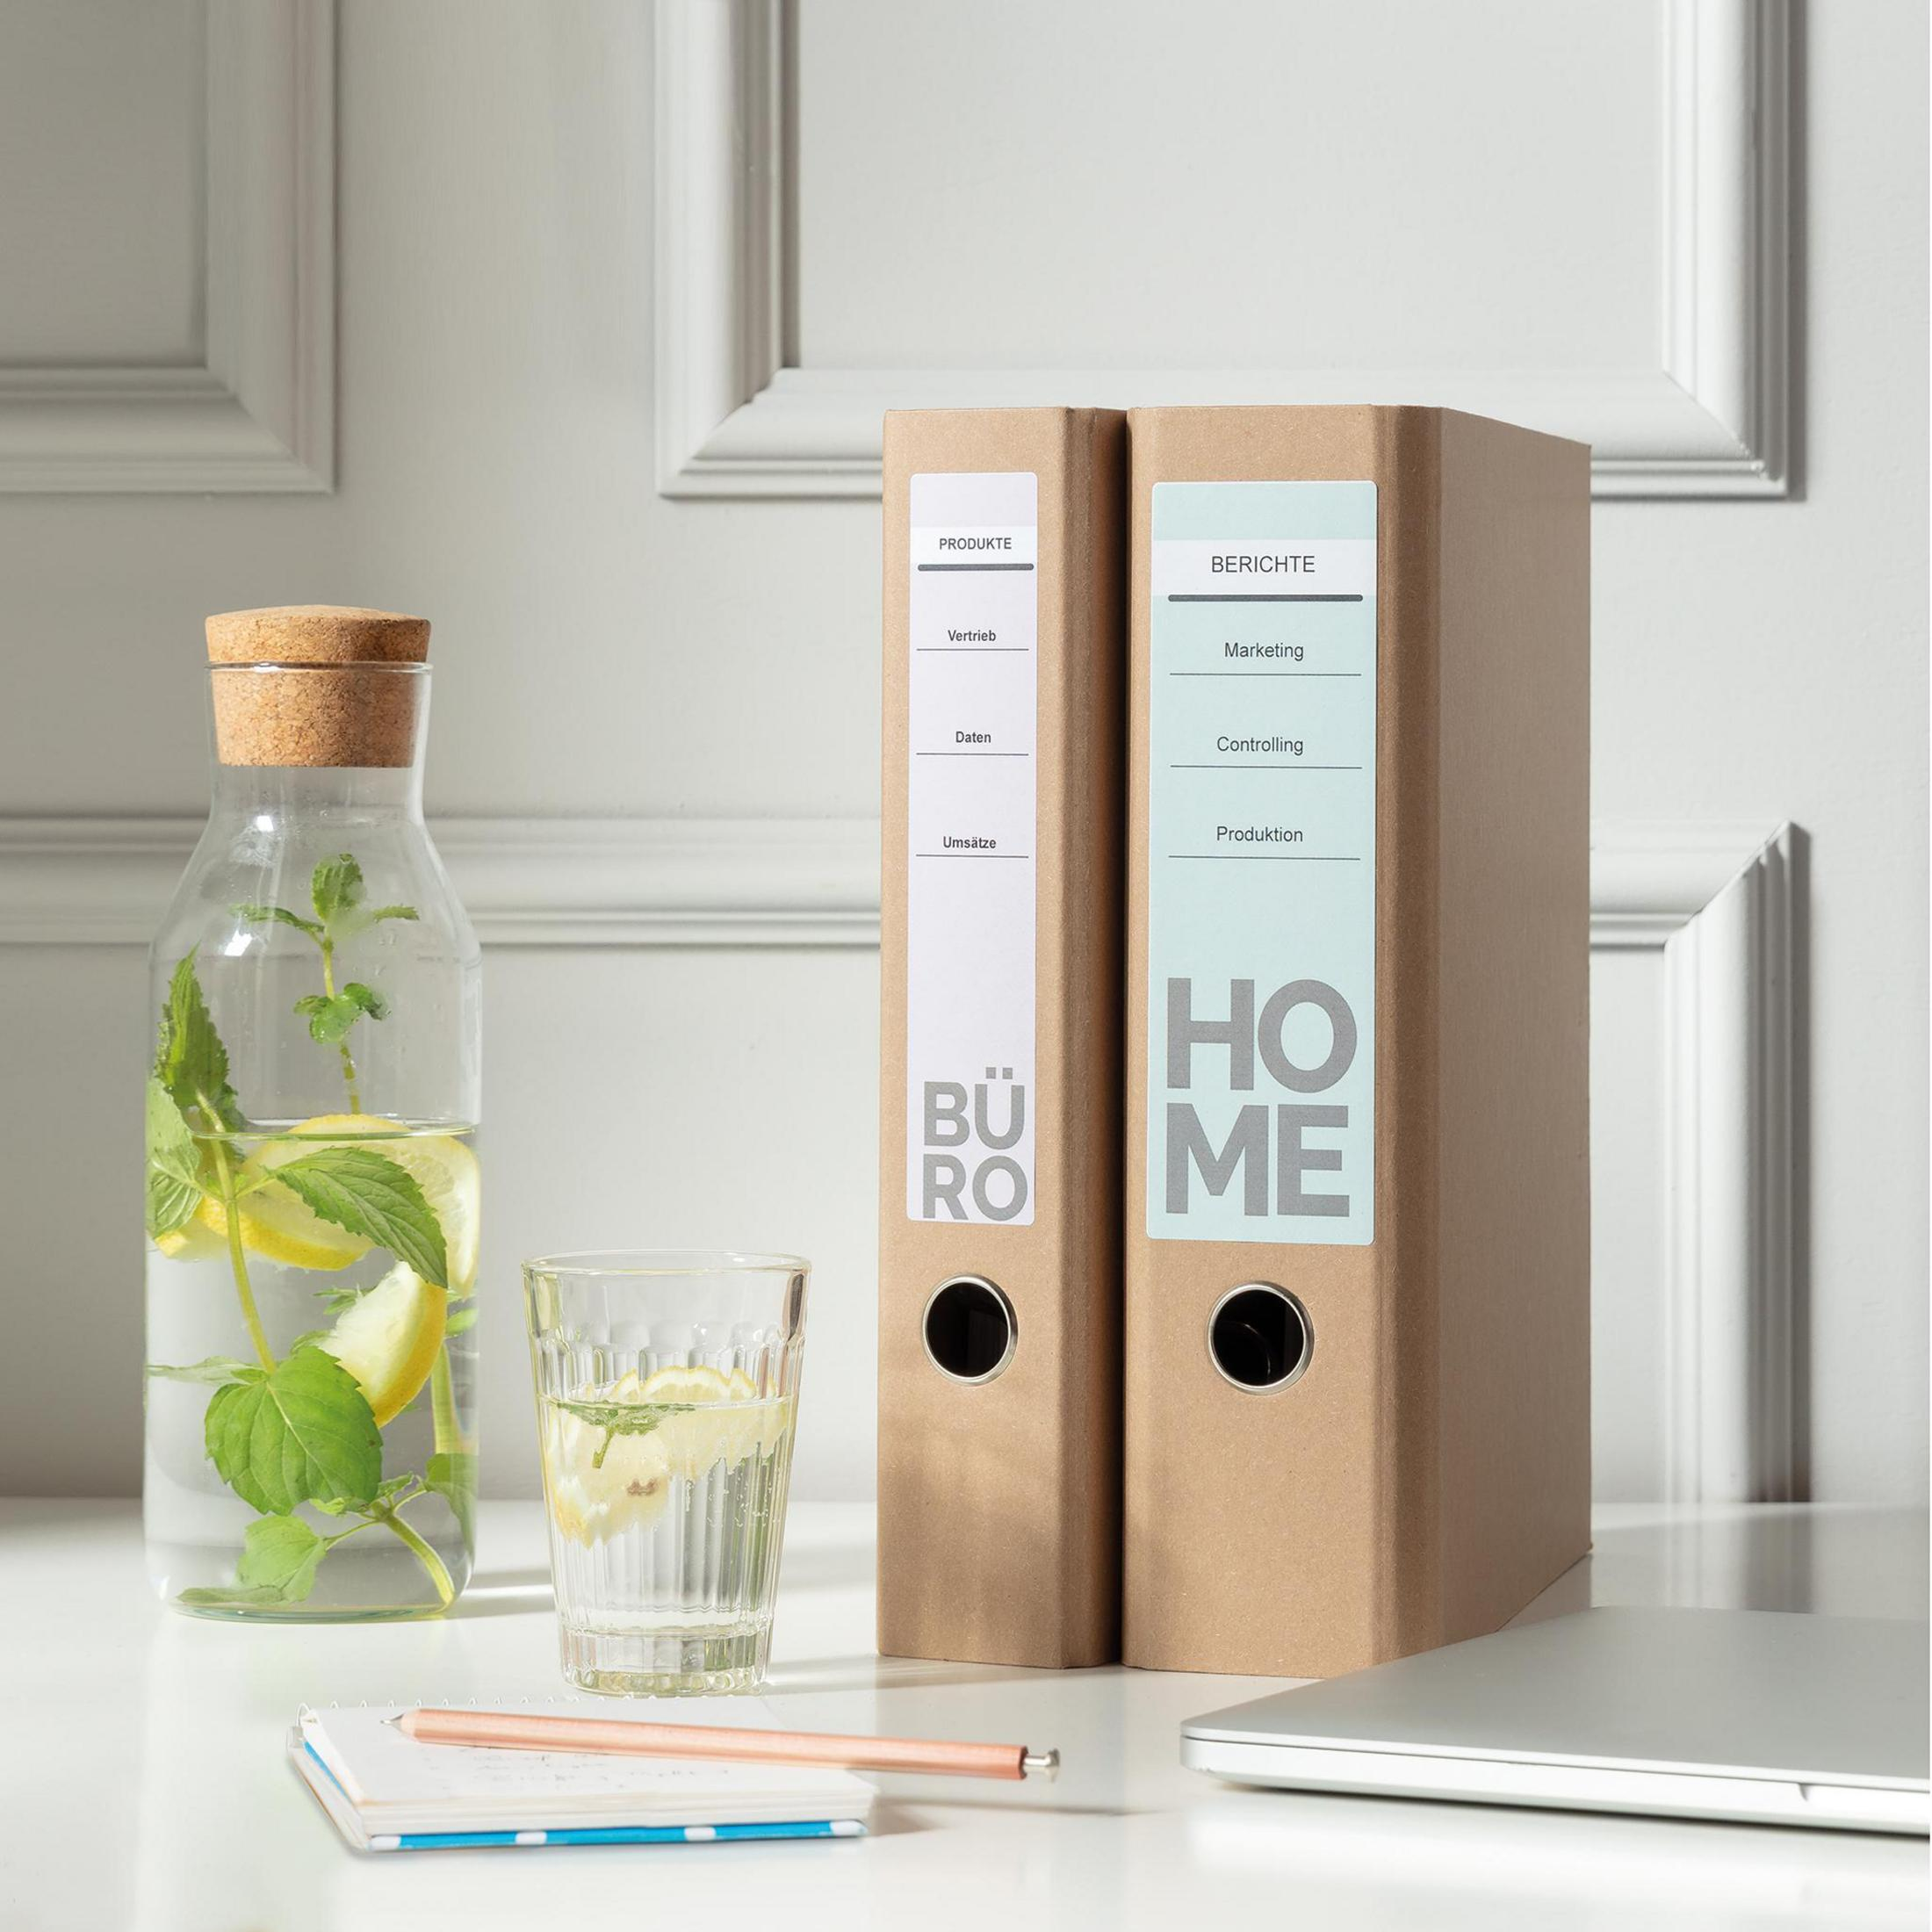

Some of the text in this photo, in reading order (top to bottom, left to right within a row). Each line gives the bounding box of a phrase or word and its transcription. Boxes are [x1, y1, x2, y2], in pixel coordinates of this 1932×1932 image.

[939, 537, 1013, 551] PRODUKTE
[1211, 555, 1316, 573] BERICHTE
[948, 629, 997, 642] Vertrieb
[1224, 642, 1305, 661] Marketing
[955, 731, 991, 744] Daten
[1217, 736, 1304, 755] Controlling
[943, 836, 997, 849] Umsätze
[1216, 825, 1304, 843] Produktion
[1166, 977, 1358, 1093] HO
[924, 1067, 1025, 1150] BÜ
[1165, 1103, 1351, 1218] ME
[922, 1153, 1028, 1222] RO
